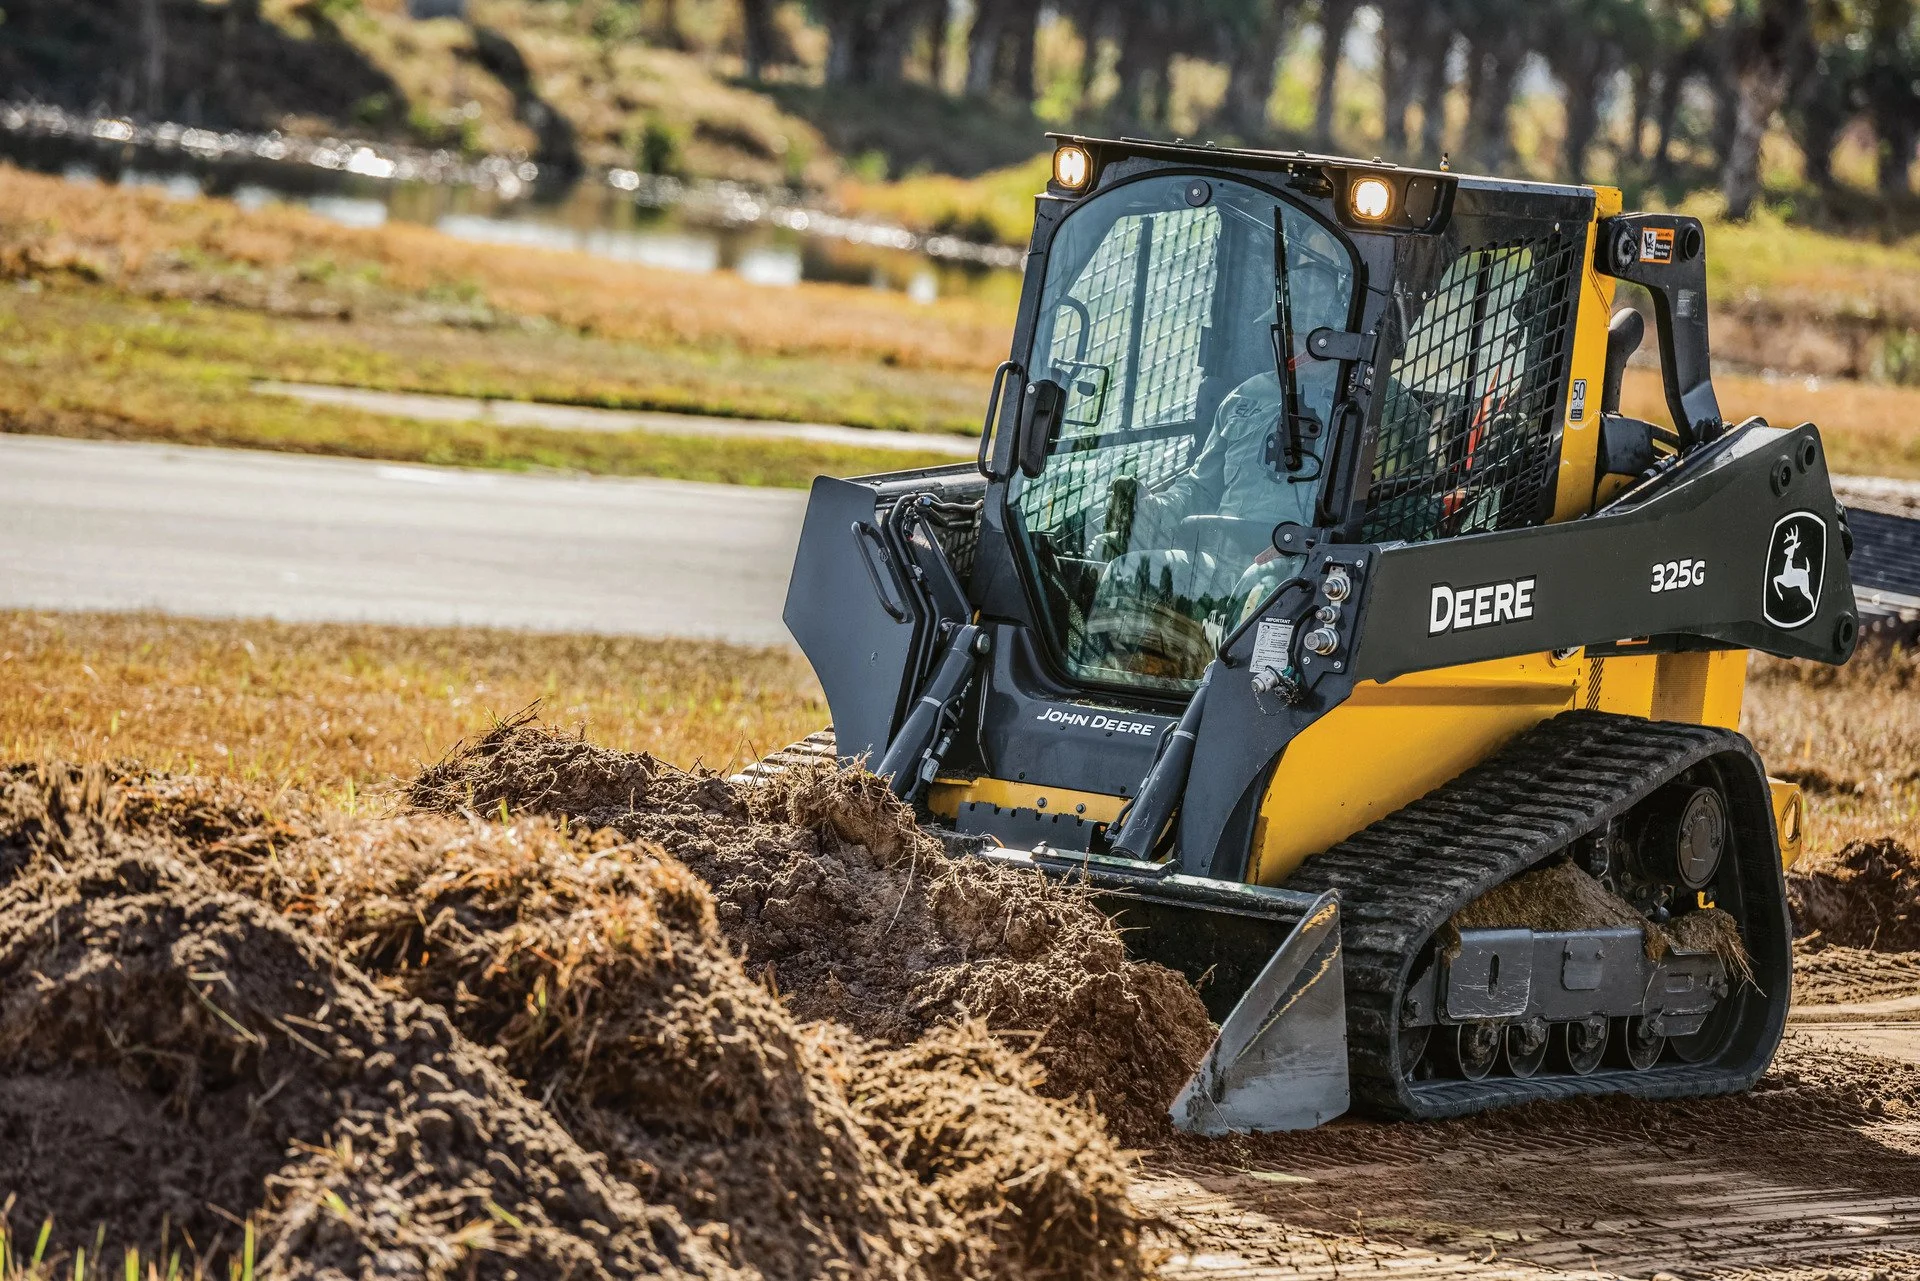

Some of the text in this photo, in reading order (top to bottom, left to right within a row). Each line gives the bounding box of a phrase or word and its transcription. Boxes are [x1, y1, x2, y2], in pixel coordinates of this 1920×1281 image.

[1573, 382, 1585, 400] 50
[1651, 559, 1705, 593] 325G
[1429, 579, 1535, 634] DEERE
[1037, 708, 1155, 736] JOHN DEERE
